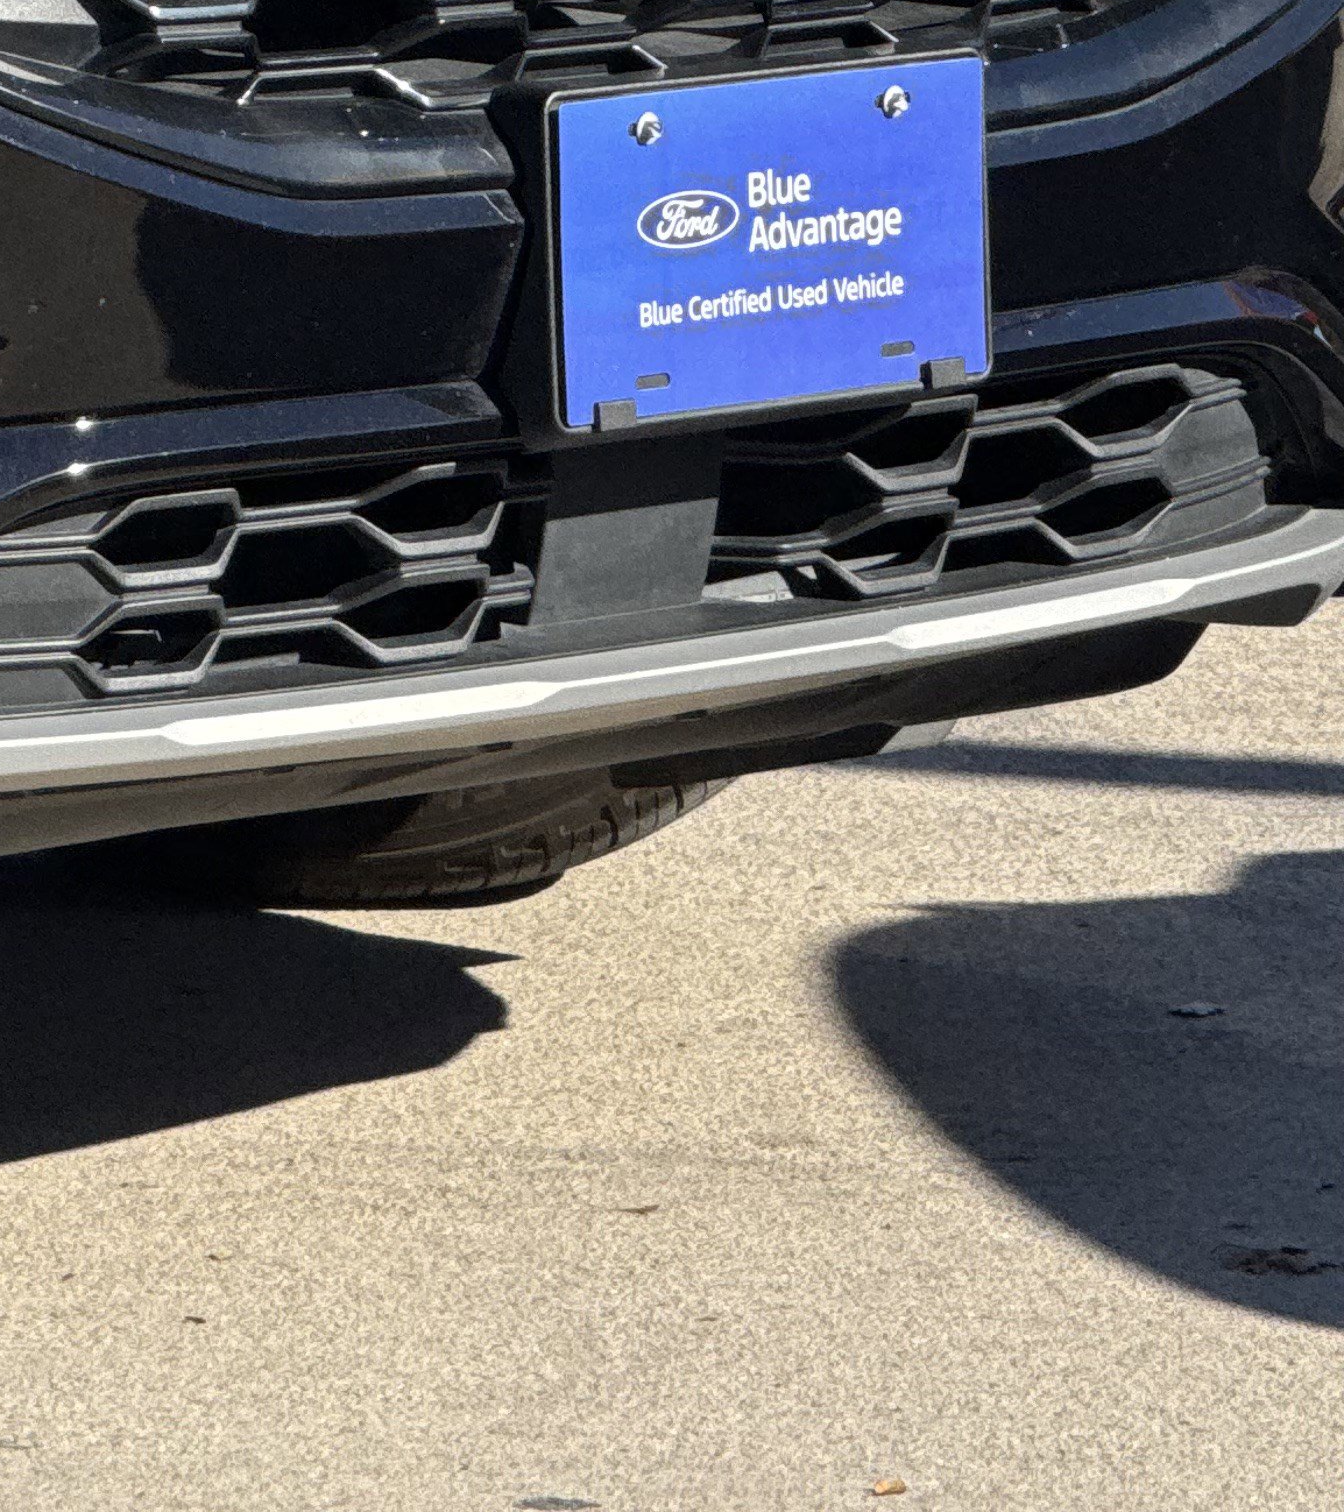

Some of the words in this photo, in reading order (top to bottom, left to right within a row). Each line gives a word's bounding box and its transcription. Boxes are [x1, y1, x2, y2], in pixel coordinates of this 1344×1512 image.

[748, 168, 811, 208] Blue
[656, 198, 719, 240] Ford
[748, 206, 902, 252] Advantage
[639, 300, 683, 328] Blue
[688, 286, 772, 321] Certified
[777, 278, 828, 310] Used
[833, 270, 904, 303] Vehicle
